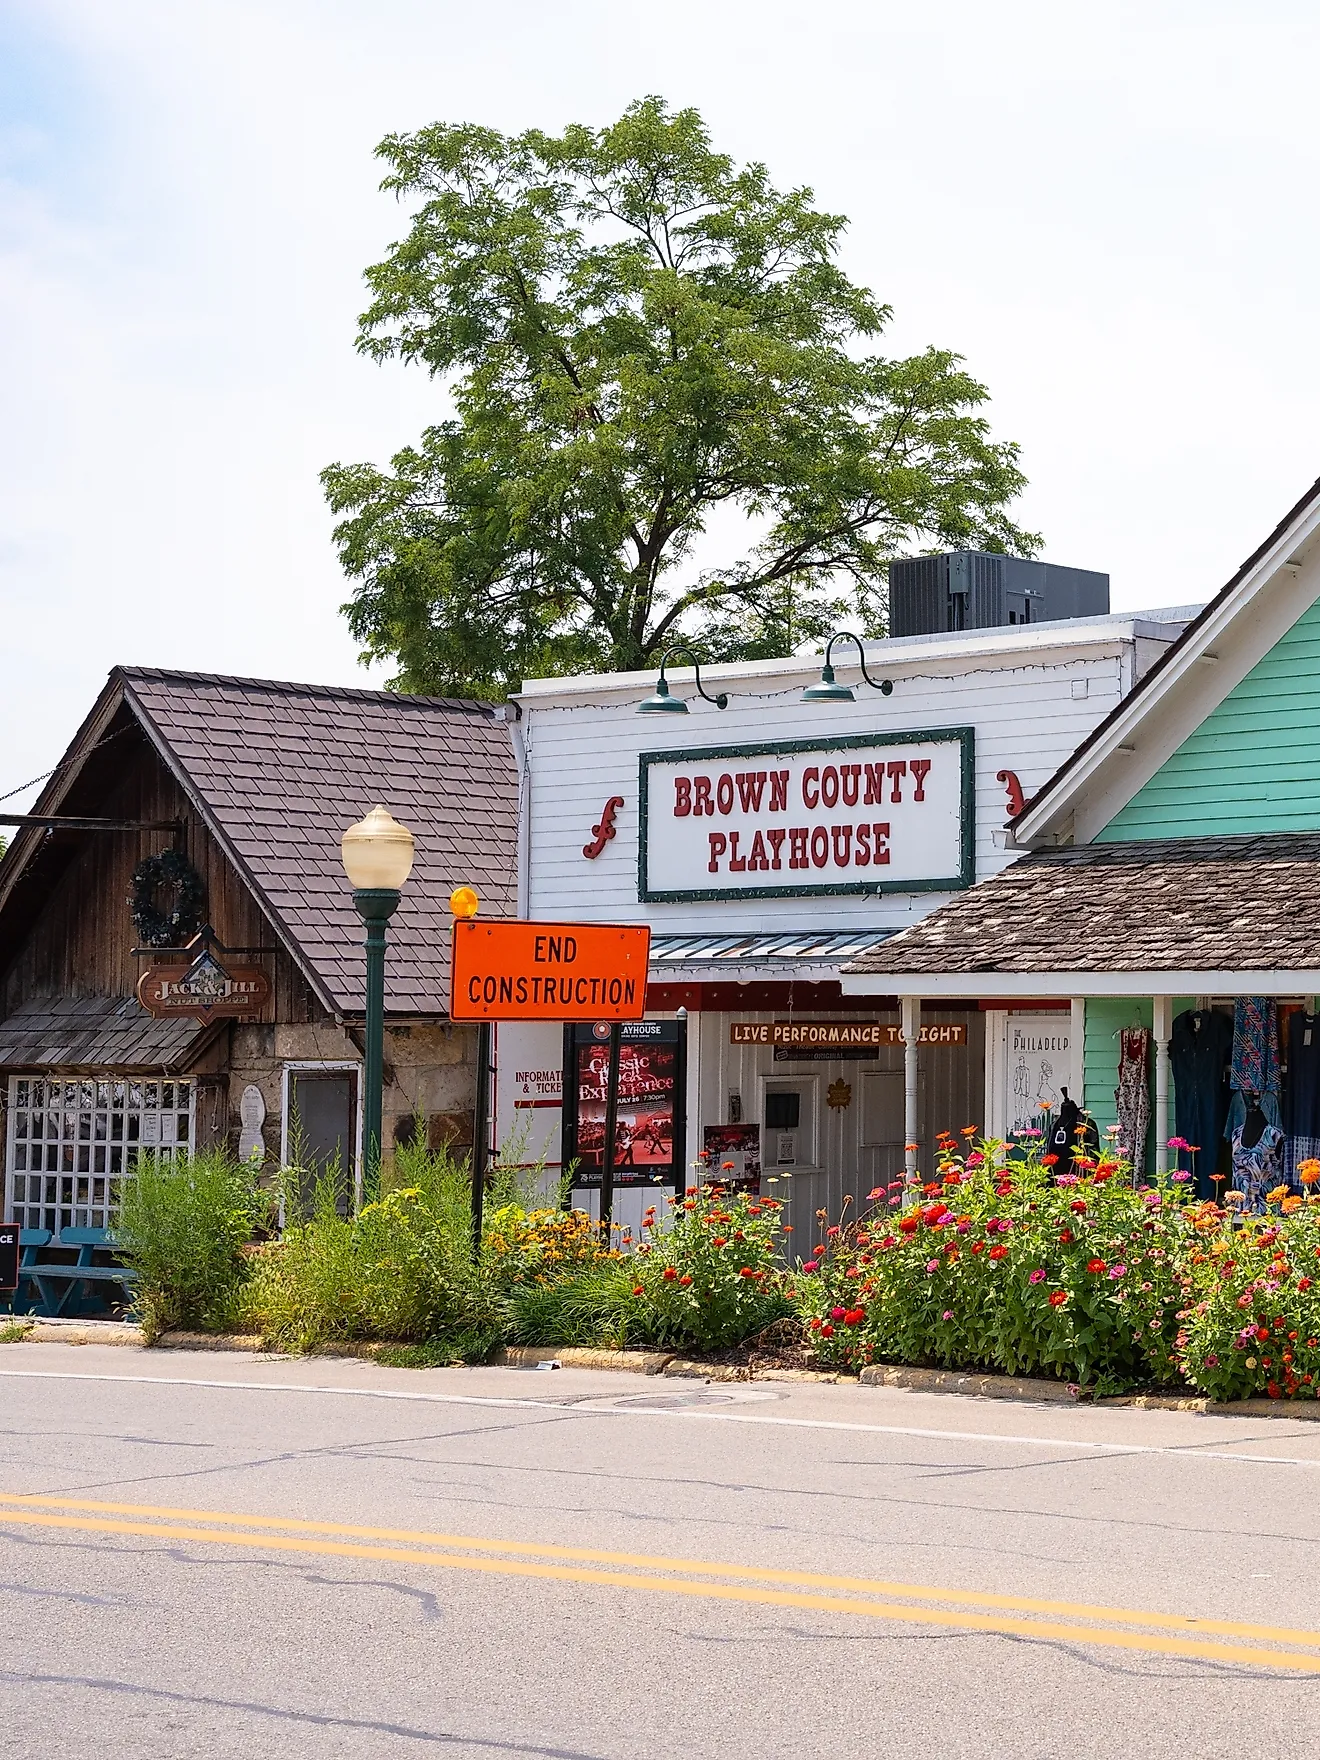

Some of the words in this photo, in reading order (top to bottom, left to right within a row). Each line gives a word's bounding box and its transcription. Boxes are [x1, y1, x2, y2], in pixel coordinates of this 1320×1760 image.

[673, 769, 791, 817] BROWN
[802, 759, 932, 810] COUNTY
[708, 822, 891, 873] PLAYHOUSE
[534, 935, 578, 964] END
[468, 975, 636, 1006] CONSTRUCTION
[735, 1026, 768, 1042] LIVE
[773, 1026, 880, 1043] PERFORMANCE
[887, 1026, 962, 1042] TOIGHT
[1013, 1037, 1069, 1051] PHILADELP
[515, 1071, 564, 1082] INFORMATI
[522, 1083, 530, 1093] &
[0, 1234, 14, 1244] CE
